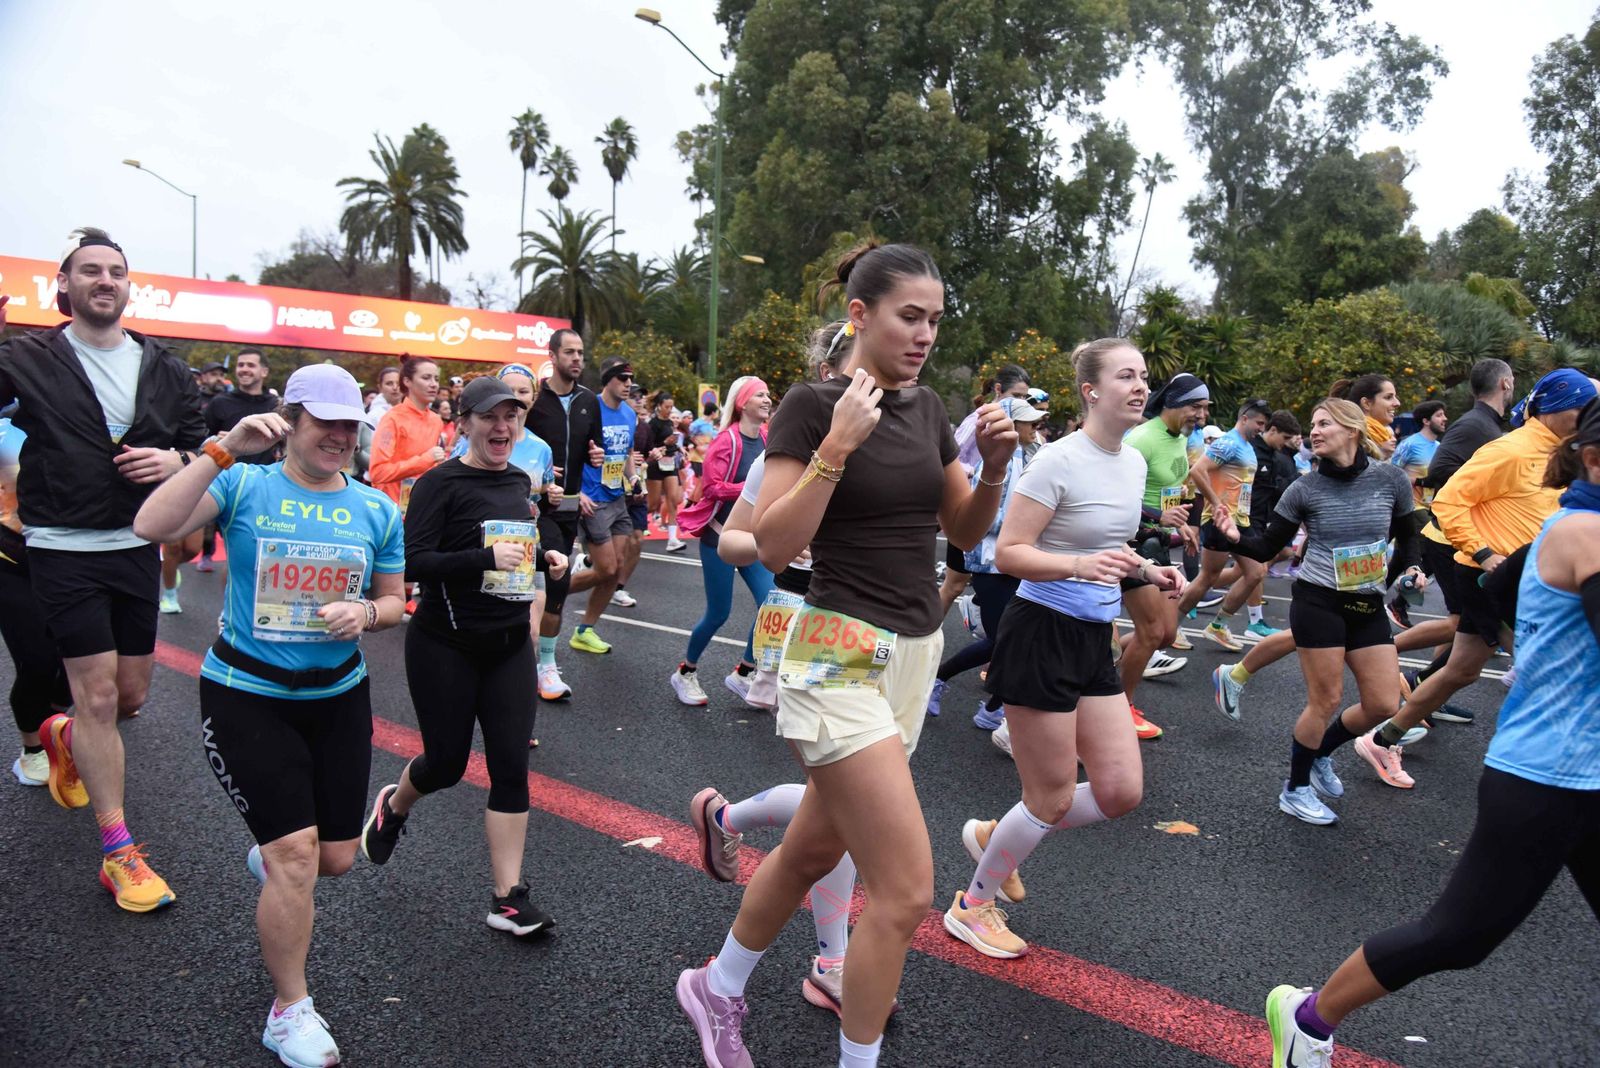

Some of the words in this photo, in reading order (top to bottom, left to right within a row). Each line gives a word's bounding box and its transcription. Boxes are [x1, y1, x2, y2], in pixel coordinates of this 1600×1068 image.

[280, 499, 352, 525] EYLO
[268, 562, 350, 593] 19265
[799, 612, 878, 655] 12365
[202, 716, 249, 813] WONG
